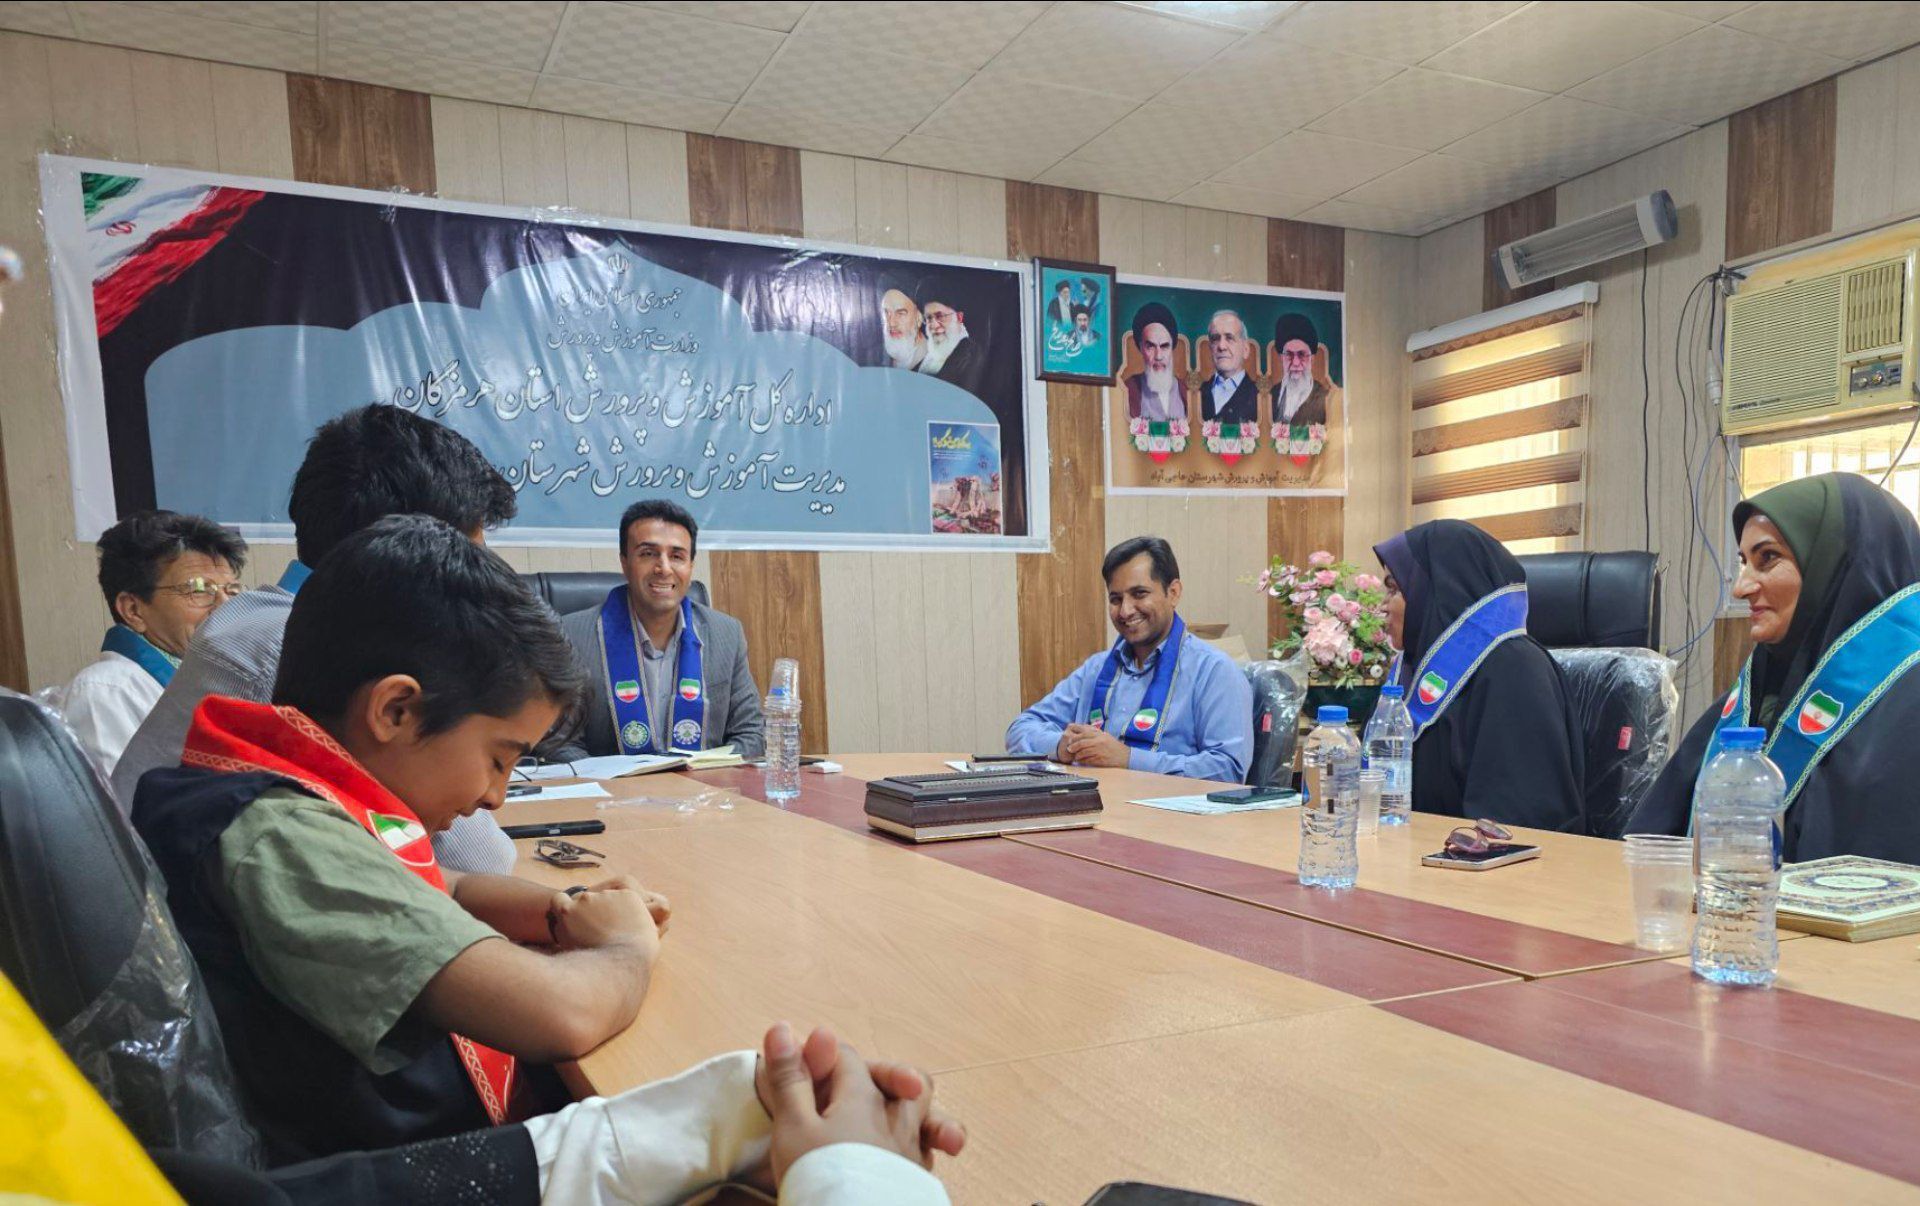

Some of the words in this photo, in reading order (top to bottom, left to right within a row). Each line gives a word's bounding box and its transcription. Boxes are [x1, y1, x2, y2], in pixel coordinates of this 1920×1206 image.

[635, 287, 683, 319] جمهوری
[547, 314, 594, 362] پرورش
[601, 319, 657, 354] آموزش
[650, 331, 700, 354] وزارت
[393, 358, 495, 418] هرمزگان
[494, 365, 562, 421] استان
[563, 363, 648, 446] پرورش
[645, 395, 661, 417] و
[661, 368, 756, 429] آموزش
[749, 367, 794, 434] کل
[783, 392, 833, 427] اداره
[498, 437, 591, 496] شهرستان
[670, 466, 686, 489] و
[685, 440, 781, 500] آموزش
[771, 464, 846, 515] مدیریت
[1187, 471, 1224, 484] شهرستان
[1224, 471, 1249, 485] پرورش
